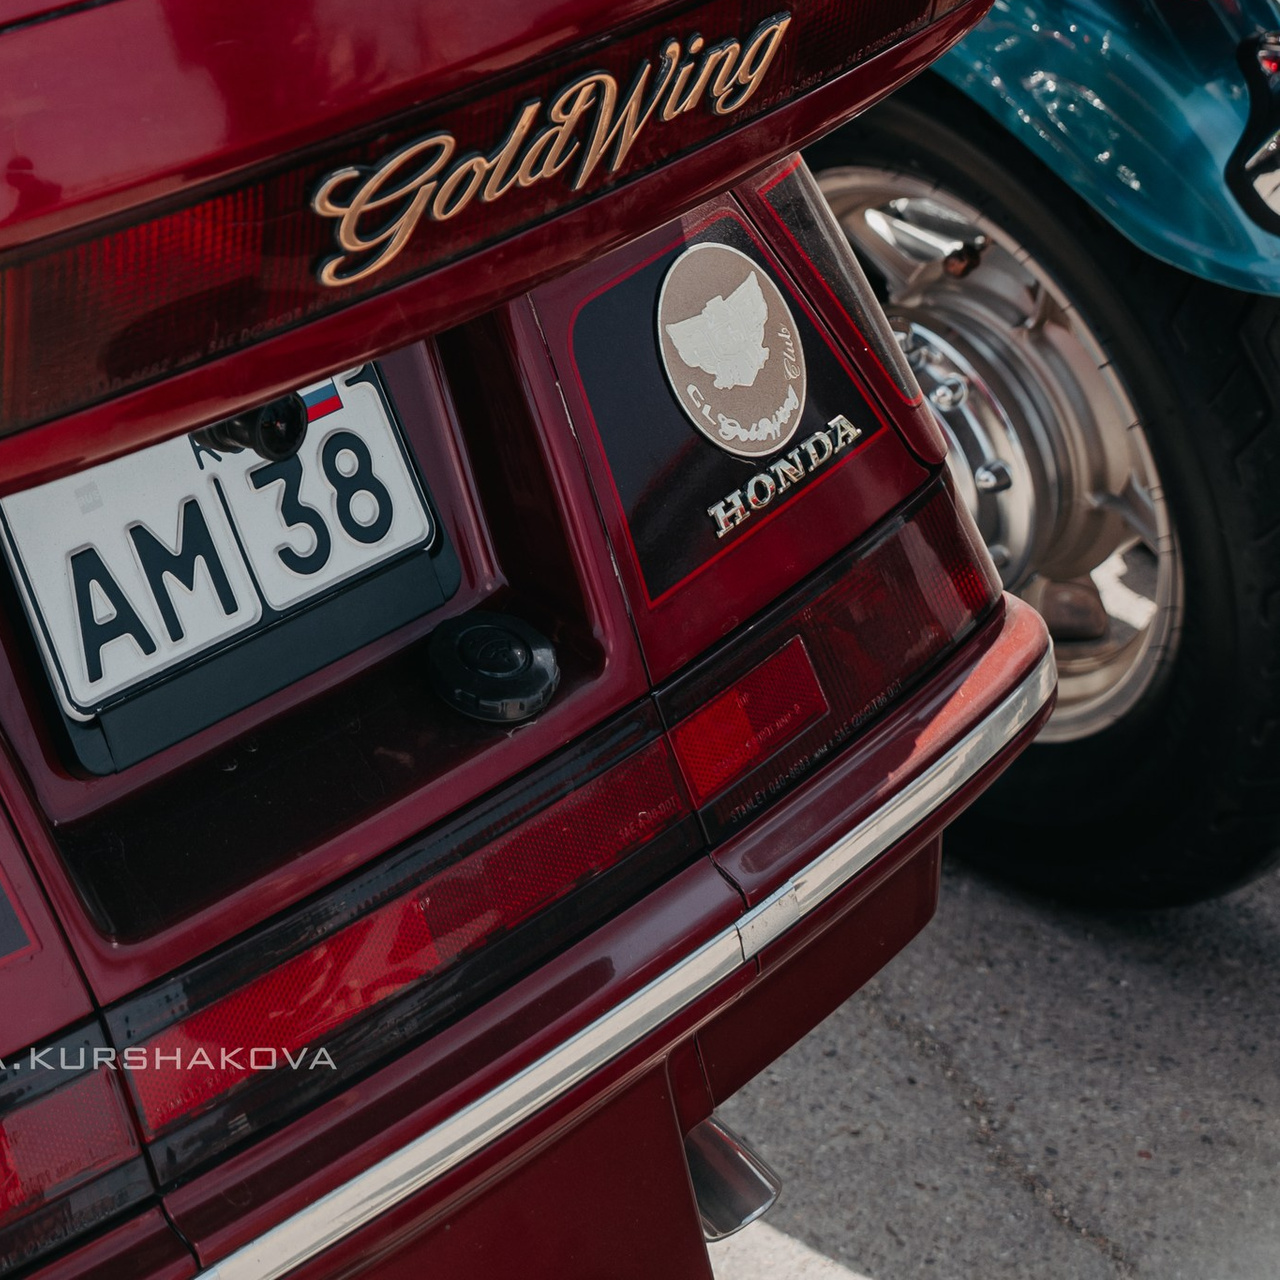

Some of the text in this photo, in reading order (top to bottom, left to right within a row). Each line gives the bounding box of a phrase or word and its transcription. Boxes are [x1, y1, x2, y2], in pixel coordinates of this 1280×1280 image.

[687, 383, 717, 426] GL
[783, 322, 802, 380] Club
[707, 414, 862, 538] HONDA
[70, 430, 394, 684] AM 38
[729, 787, 768, 824] STANLEY
[836, 721, 851, 742] SAE
[888, 678, 903, 699] DOT
